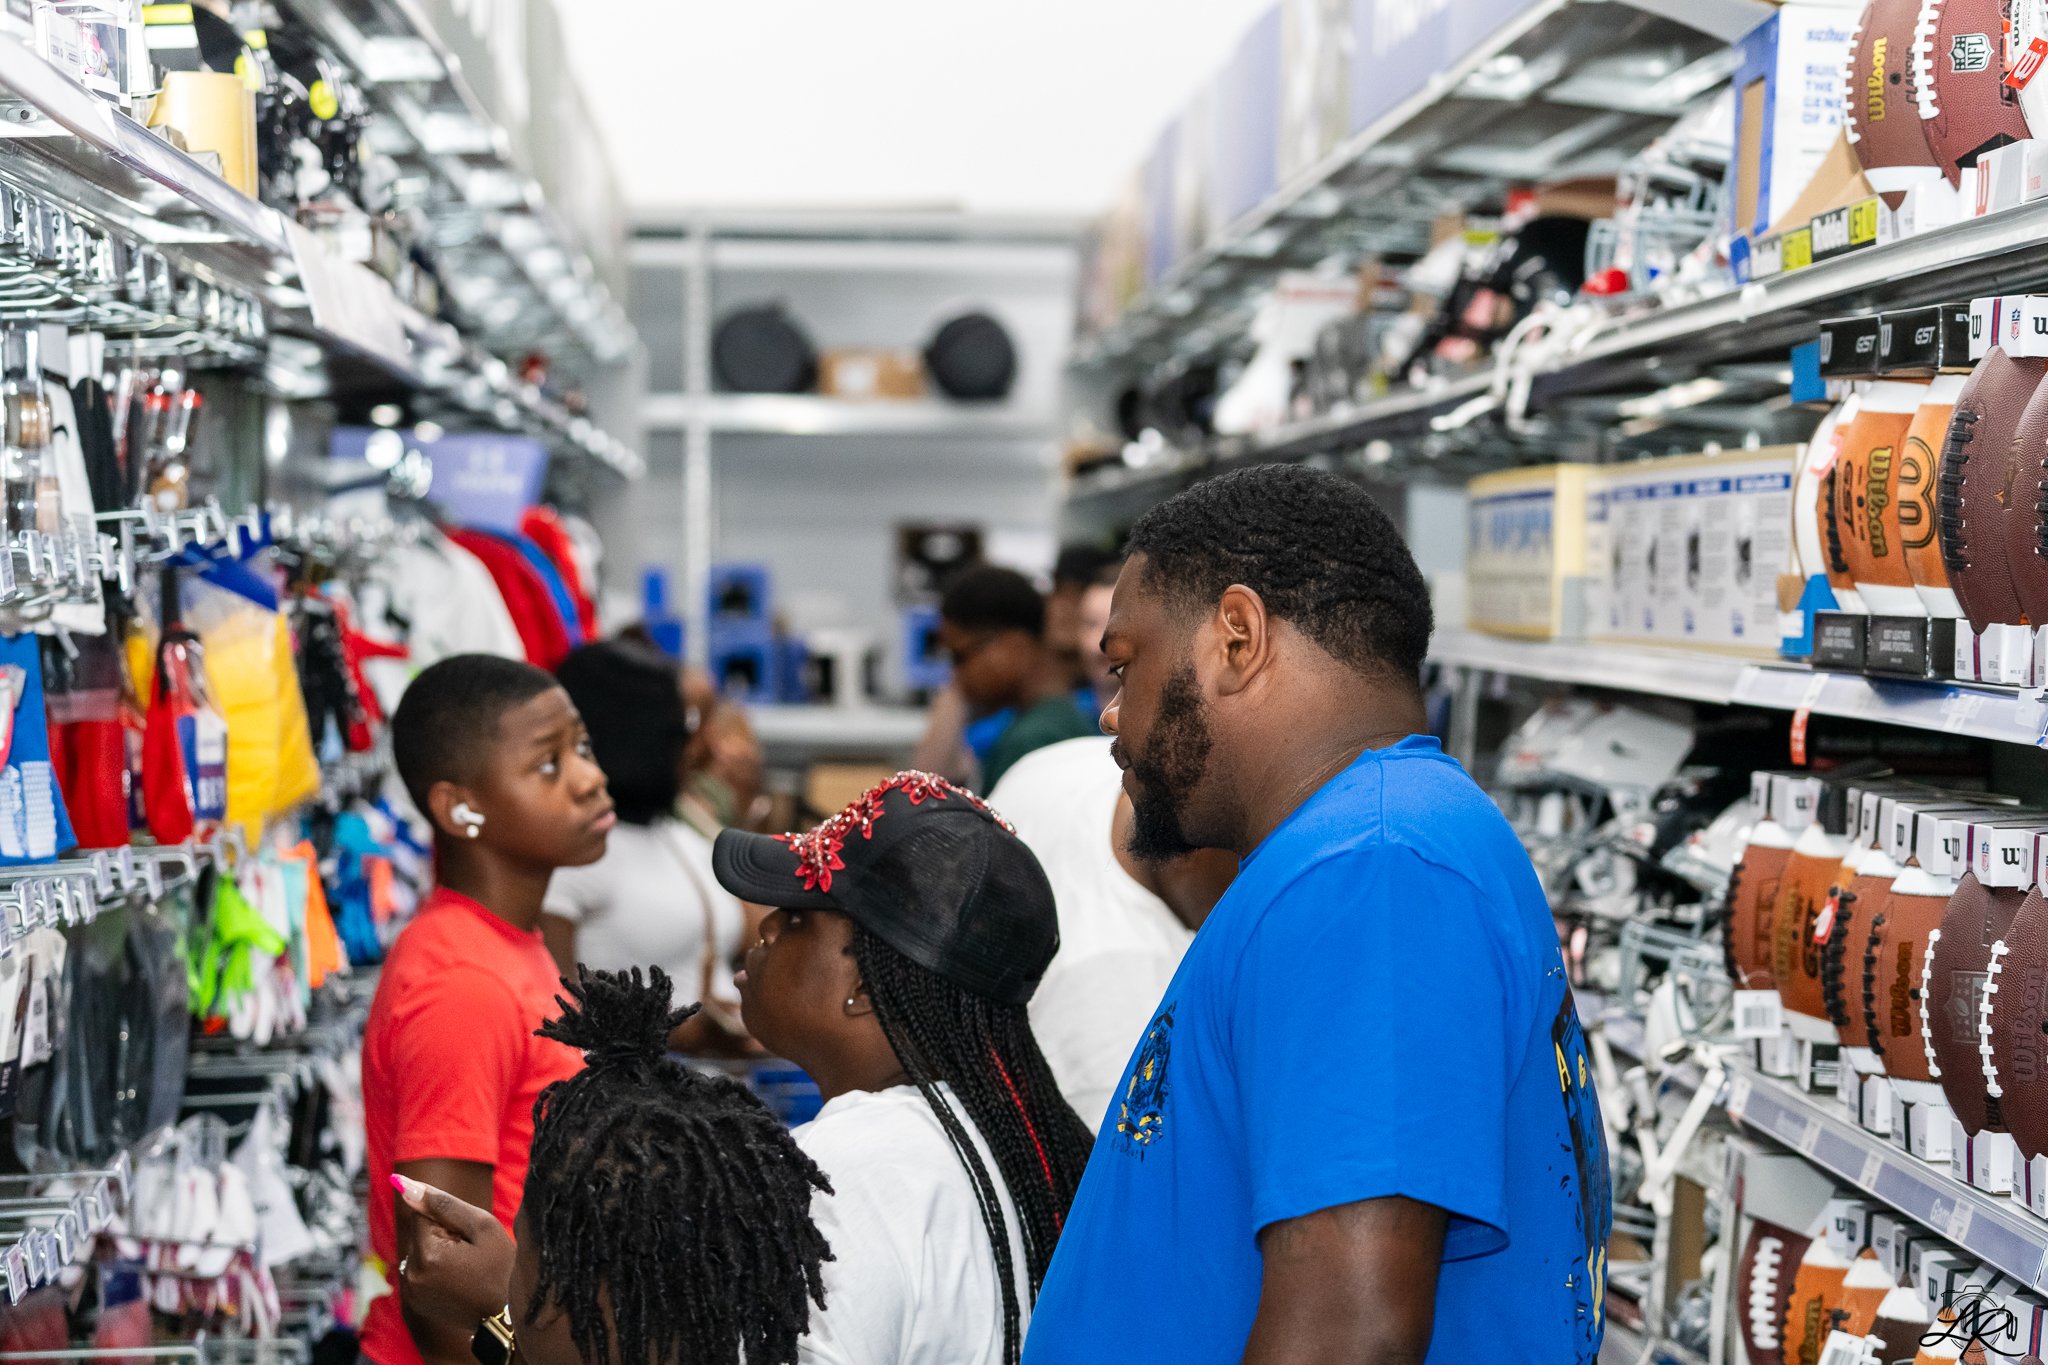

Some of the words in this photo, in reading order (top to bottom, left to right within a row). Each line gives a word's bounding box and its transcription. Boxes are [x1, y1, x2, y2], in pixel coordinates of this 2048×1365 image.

[1967, 37, 1985, 67] NFL
[1866, 36, 1888, 122] Wilson
[1955, 313, 1970, 323] EV
[1971, 314, 1982, 340] W
[1855, 334, 1878, 354] GST
[1914, 325, 1937, 346] GST
[1866, 446, 1893, 558] Wilson
[2011, 967, 2045, 1082] Wilson
